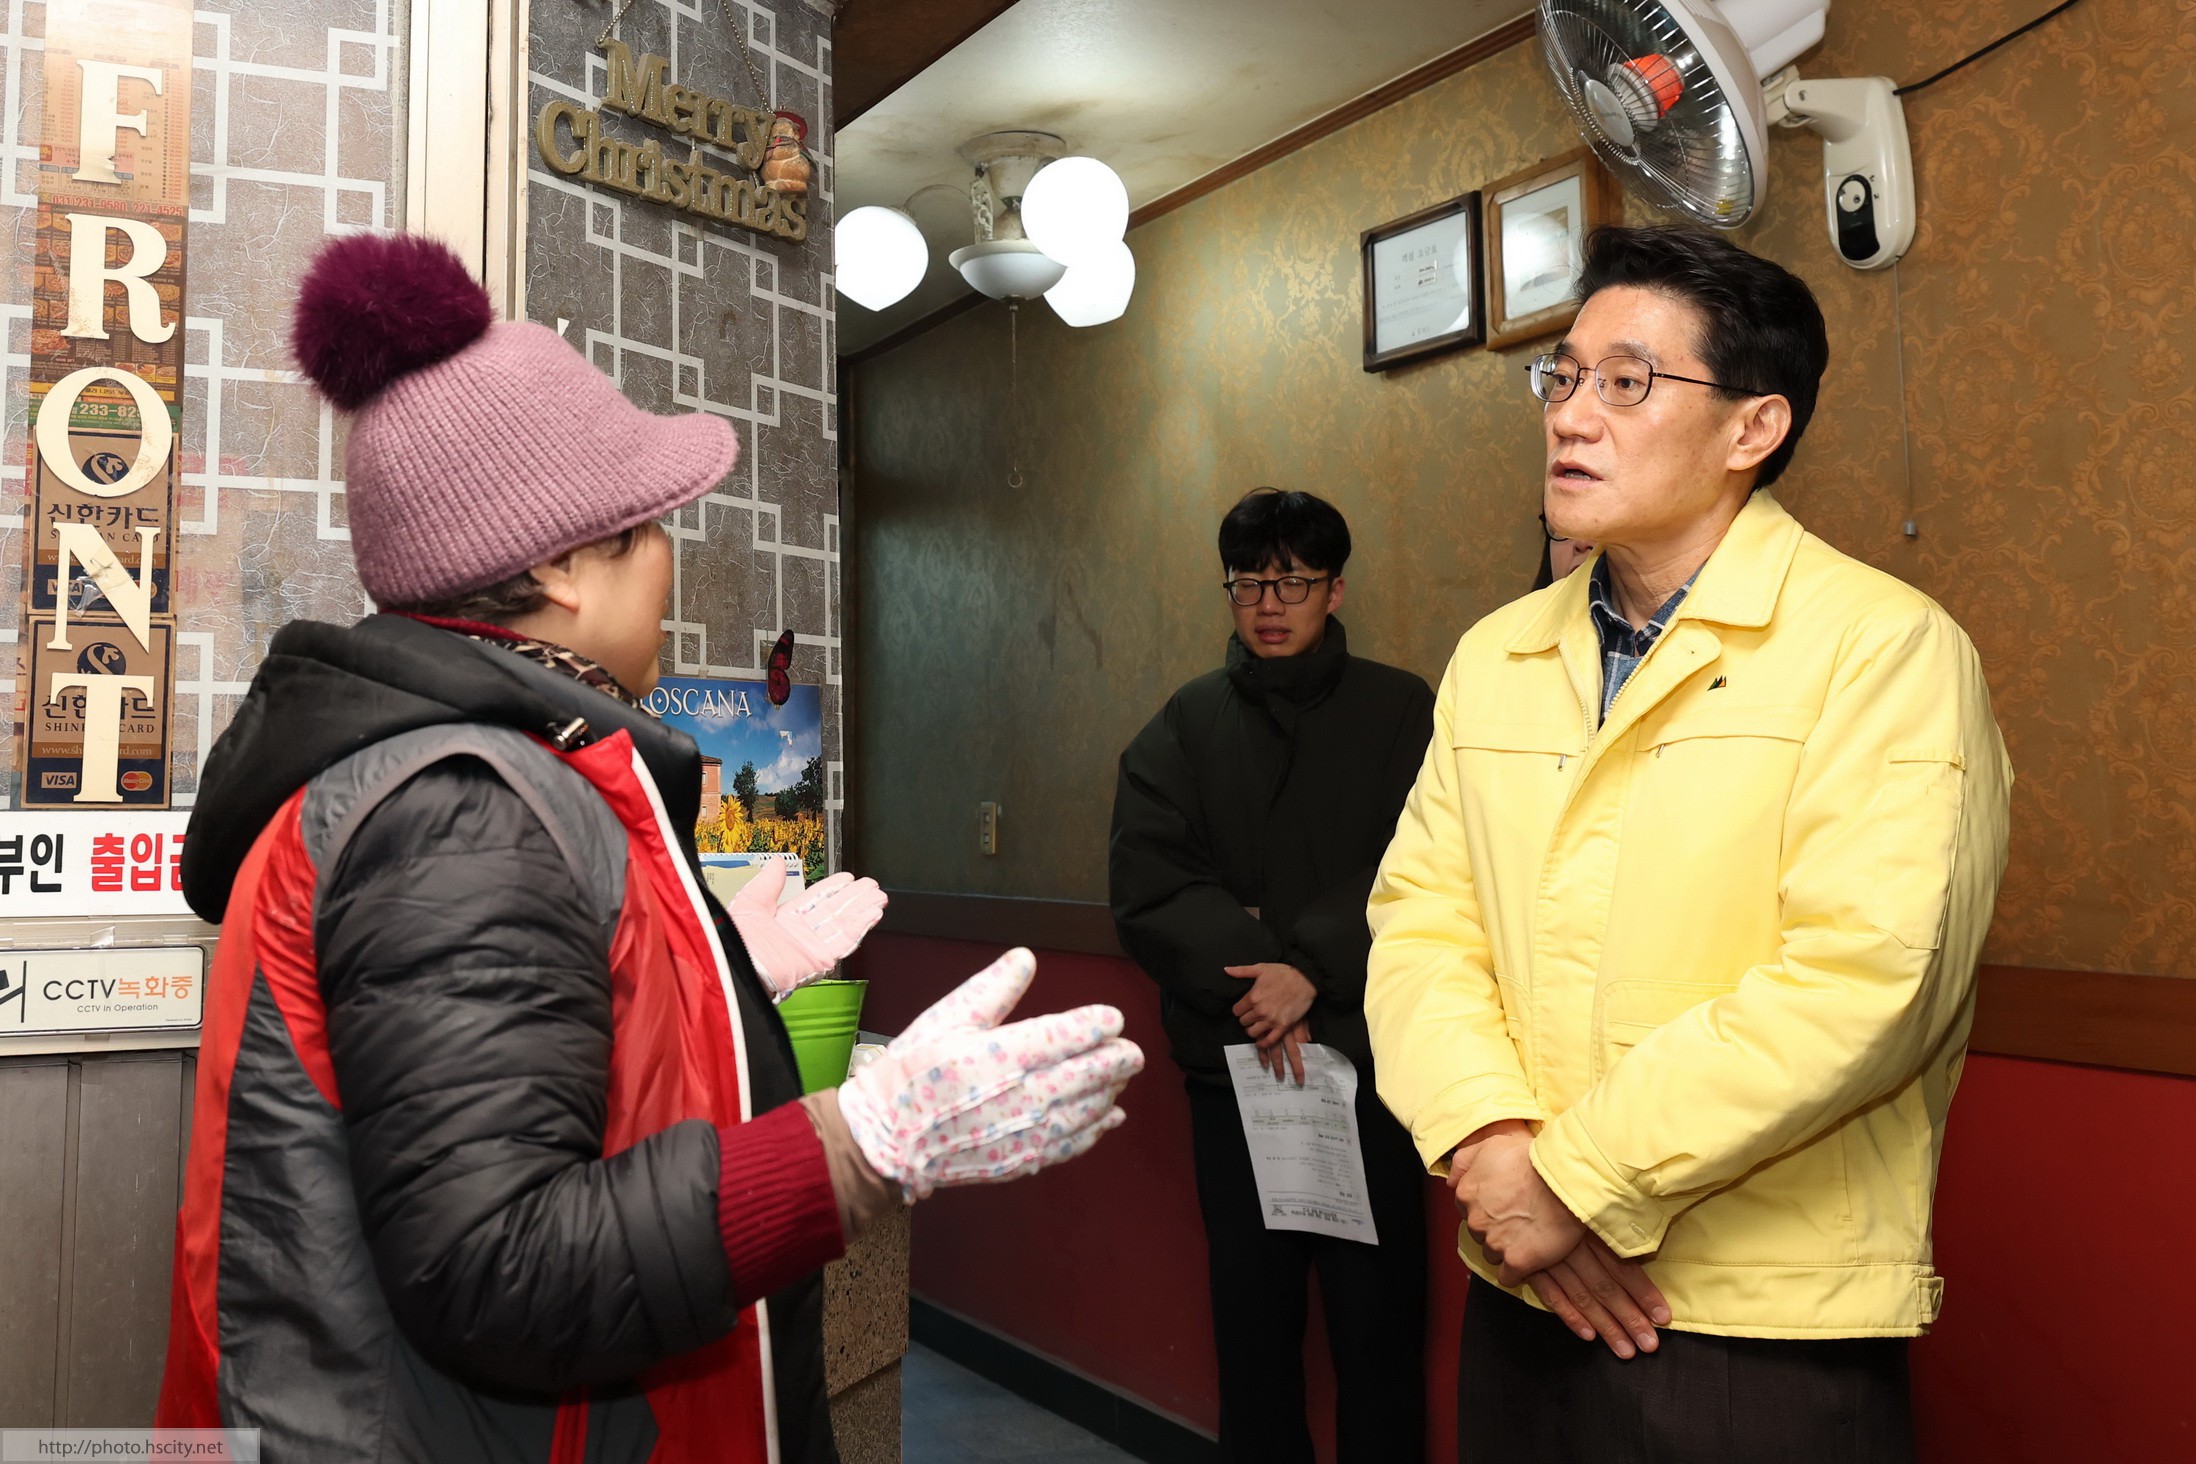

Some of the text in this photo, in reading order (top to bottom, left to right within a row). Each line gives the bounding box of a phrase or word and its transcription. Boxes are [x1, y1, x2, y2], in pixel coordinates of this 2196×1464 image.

[596, 38, 776, 172] Merry
[537, 99, 807, 243] Christmas
[79, 403, 141, 418] 233-82
[36, 59, 176, 803] FRONT
[47, 503, 159, 530] 신한카드
[648, 686, 752, 718] OSCANA
[46, 774, 75, 787] VISA
[43, 975, 193, 1001] CCTV녹화중
[77, 1003, 159, 1013] CCTV In Operation
